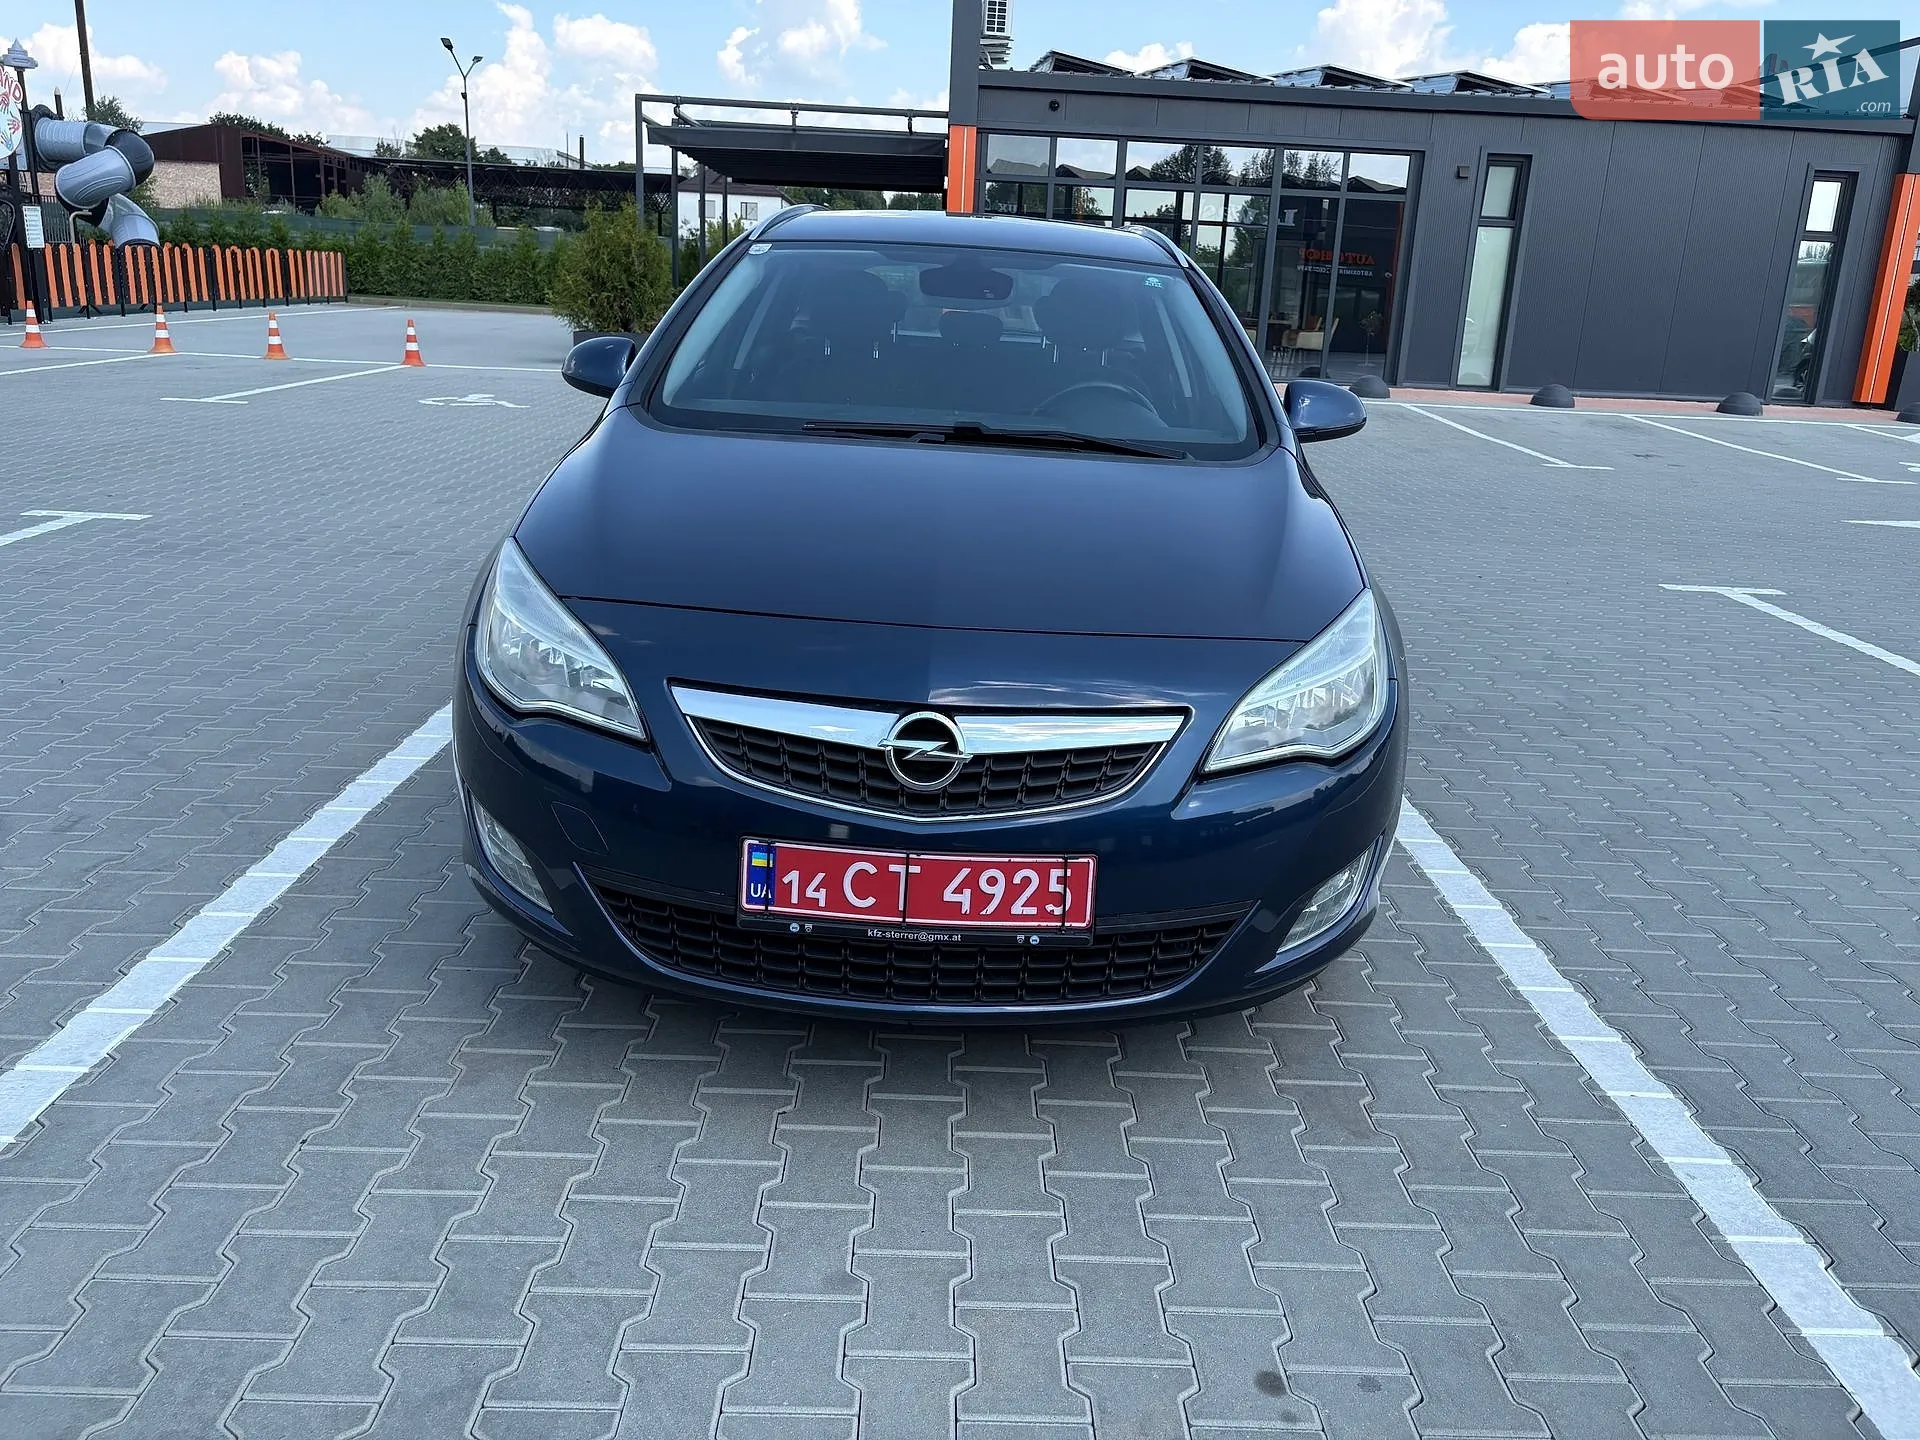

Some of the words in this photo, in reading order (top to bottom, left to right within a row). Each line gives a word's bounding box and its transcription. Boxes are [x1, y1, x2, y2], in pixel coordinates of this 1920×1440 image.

[750, 883, 772, 899] UA
[782, 869, 827, 908] 14
[842, 861, 921, 912] CT
[943, 867, 1072, 916] 4925
[867, 928, 962, 942] kfz-sterrer@gmx.at
